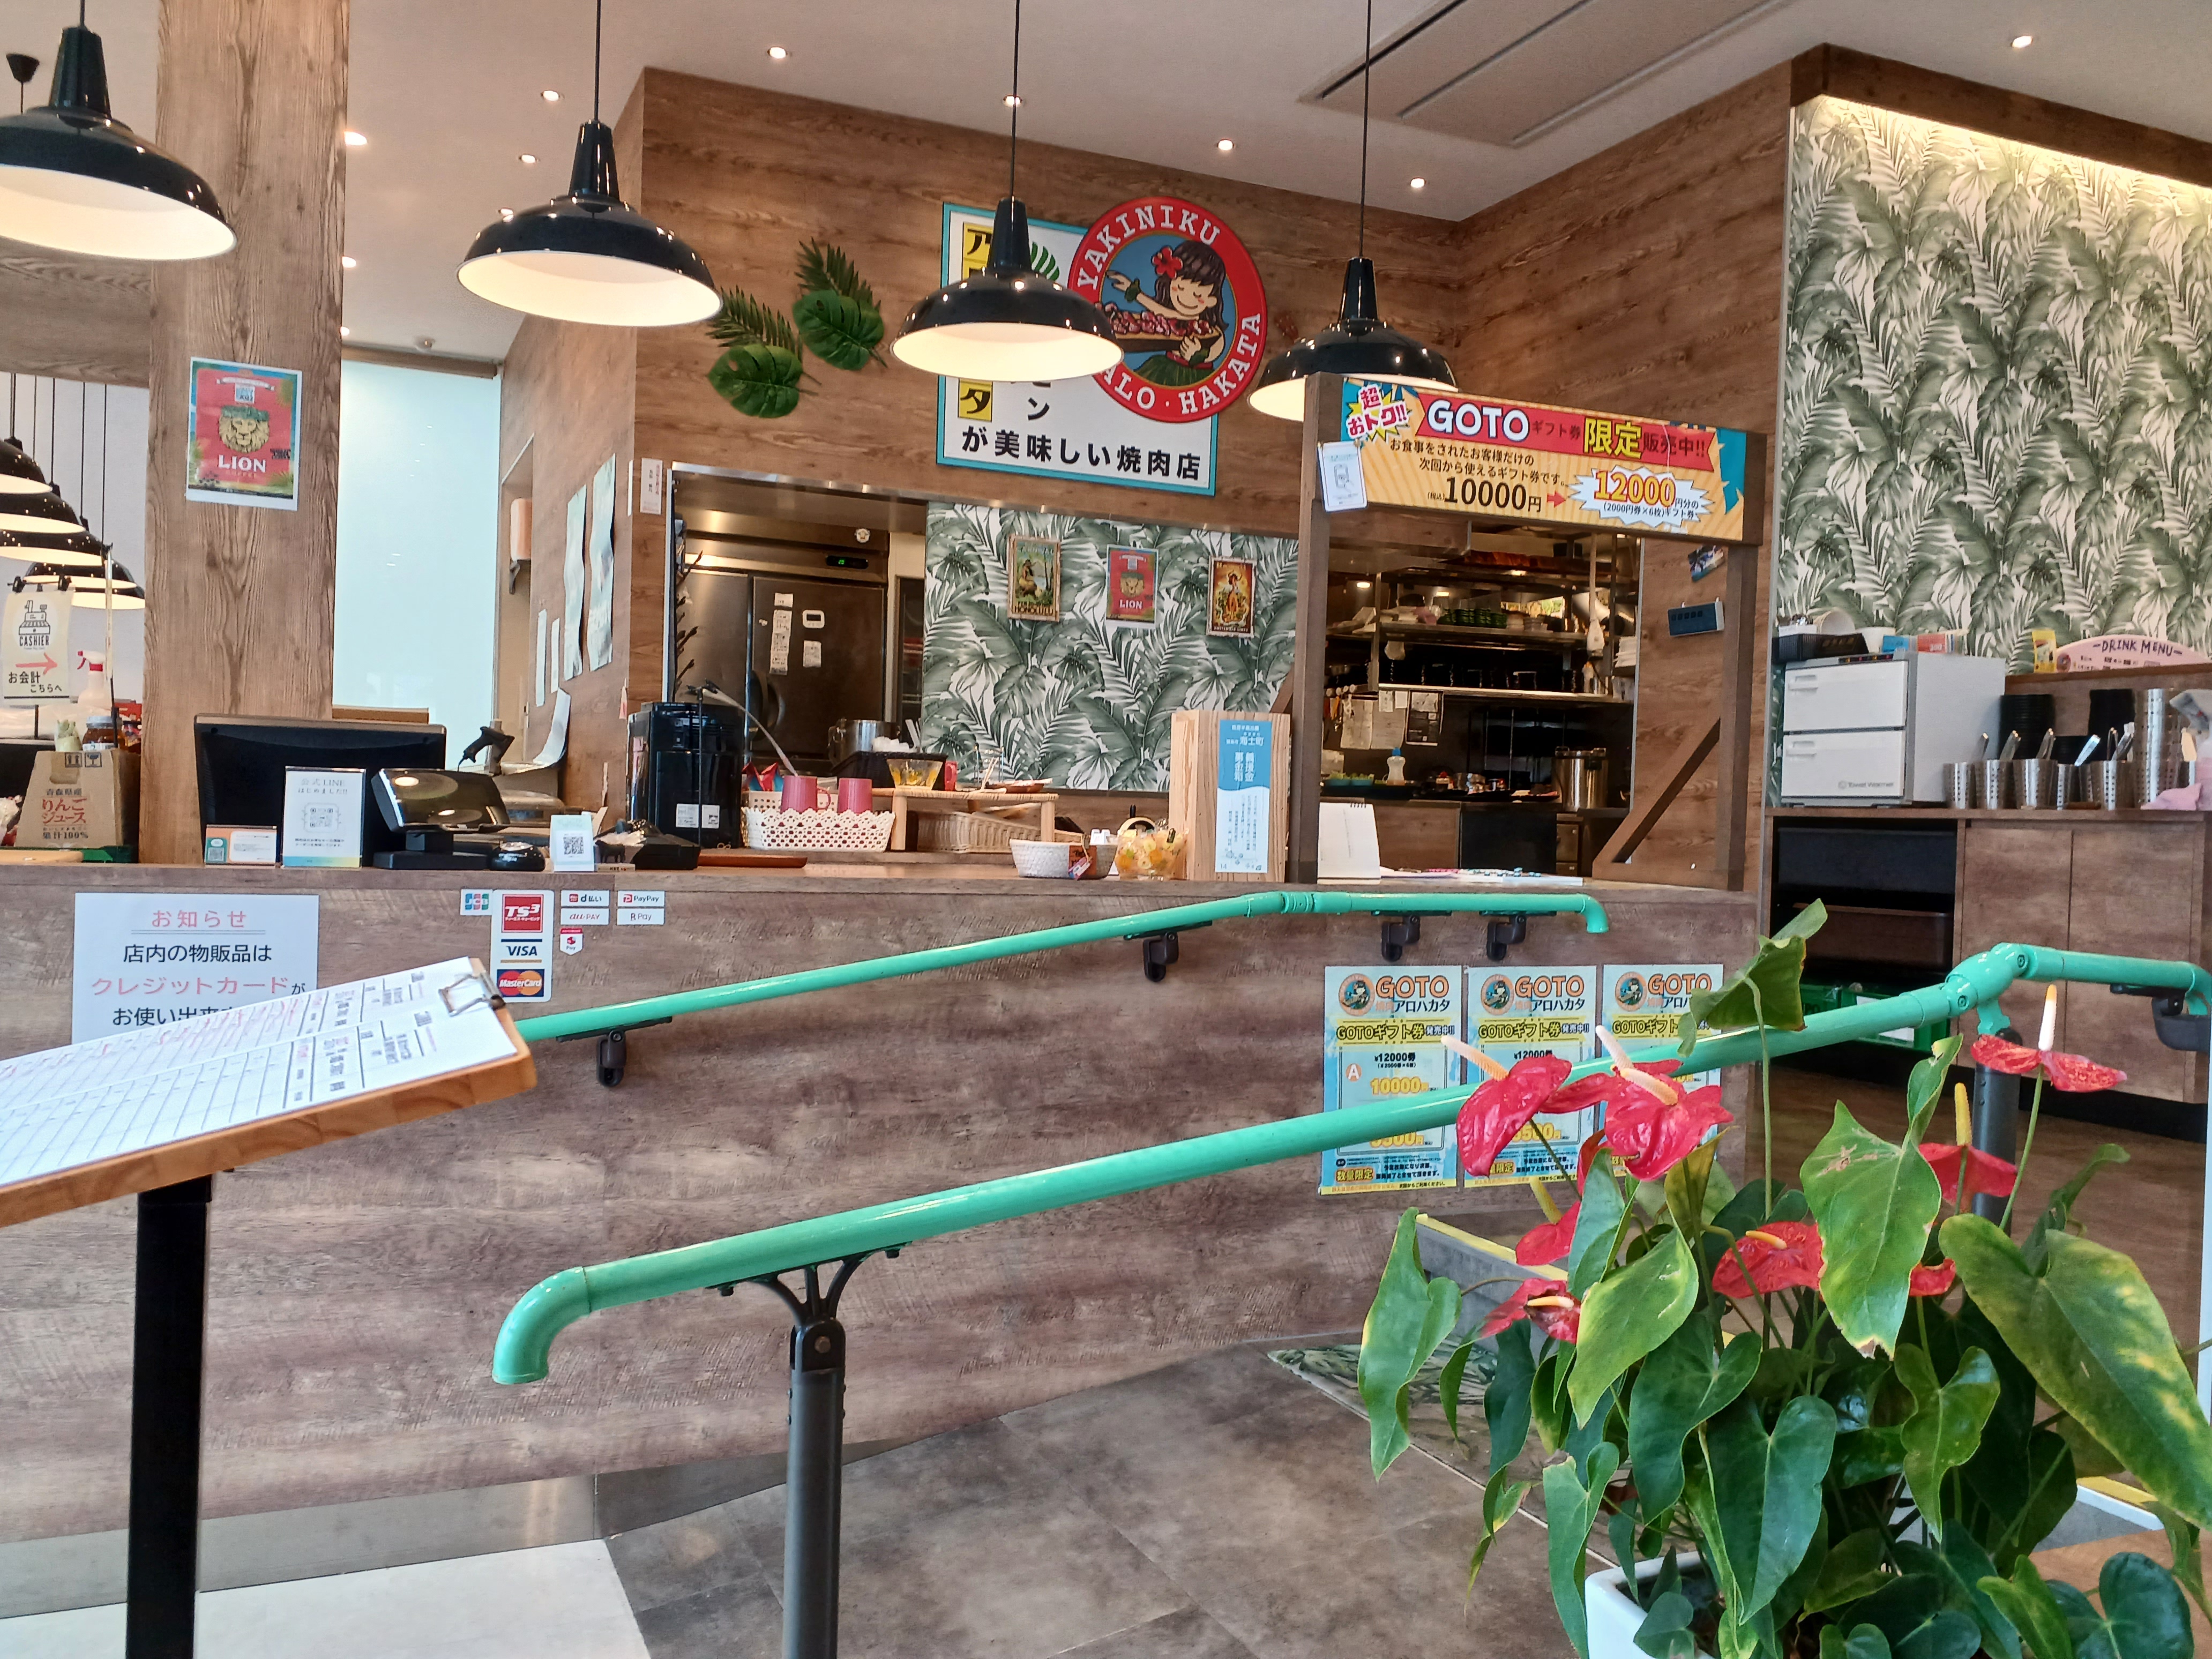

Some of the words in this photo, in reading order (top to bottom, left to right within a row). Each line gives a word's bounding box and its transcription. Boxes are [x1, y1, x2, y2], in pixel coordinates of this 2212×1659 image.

[1077, 205, 1221, 290] YAKINIKU
[1178, 313, 1261, 414] HAKATA
[1359, 385, 1381, 409] 超
[1426, 399, 1530, 442] GOTO
[1584, 417, 1642, 459] 限定
[962, 425, 1201, 481] が美味しい焼肉店
[1390, 439, 1534, 466] お食事をされたお客様だけの
[218, 453, 266, 473] LION
[1119, 599, 1142, 610] LION
[19, 635, 49, 646] CASHIER
[2102, 639, 2137, 653] DRINK
[2140, 639, 2174, 657] MENU
[8, 671, 41, 684] お会計
[31, 684, 62, 693] こちらへ
[42, 811, 86, 824] ジュース
[633, 895, 660, 903] PayPay
[152, 909, 246, 928] お知らせ
[638, 913, 652, 921] Pay
[123, 944, 272, 963] 店内の物販品は
[506, 945, 537, 956] VISA
[91, 977, 305, 996] クレジットカードが
[498, 978, 542, 988] MasterCard
[1376, 975, 1449, 999] GOTO
[1514, 975, 1585, 998] GOTO
[1648, 973, 1712, 995] GOTO
[113, 1006, 233, 1026] お使い出
[1336, 1023, 1425, 1041] GOTOギフト券
[1478, 1021, 1561, 1038] GOTOギフト券
[1348, 1064, 1359, 1080] A
